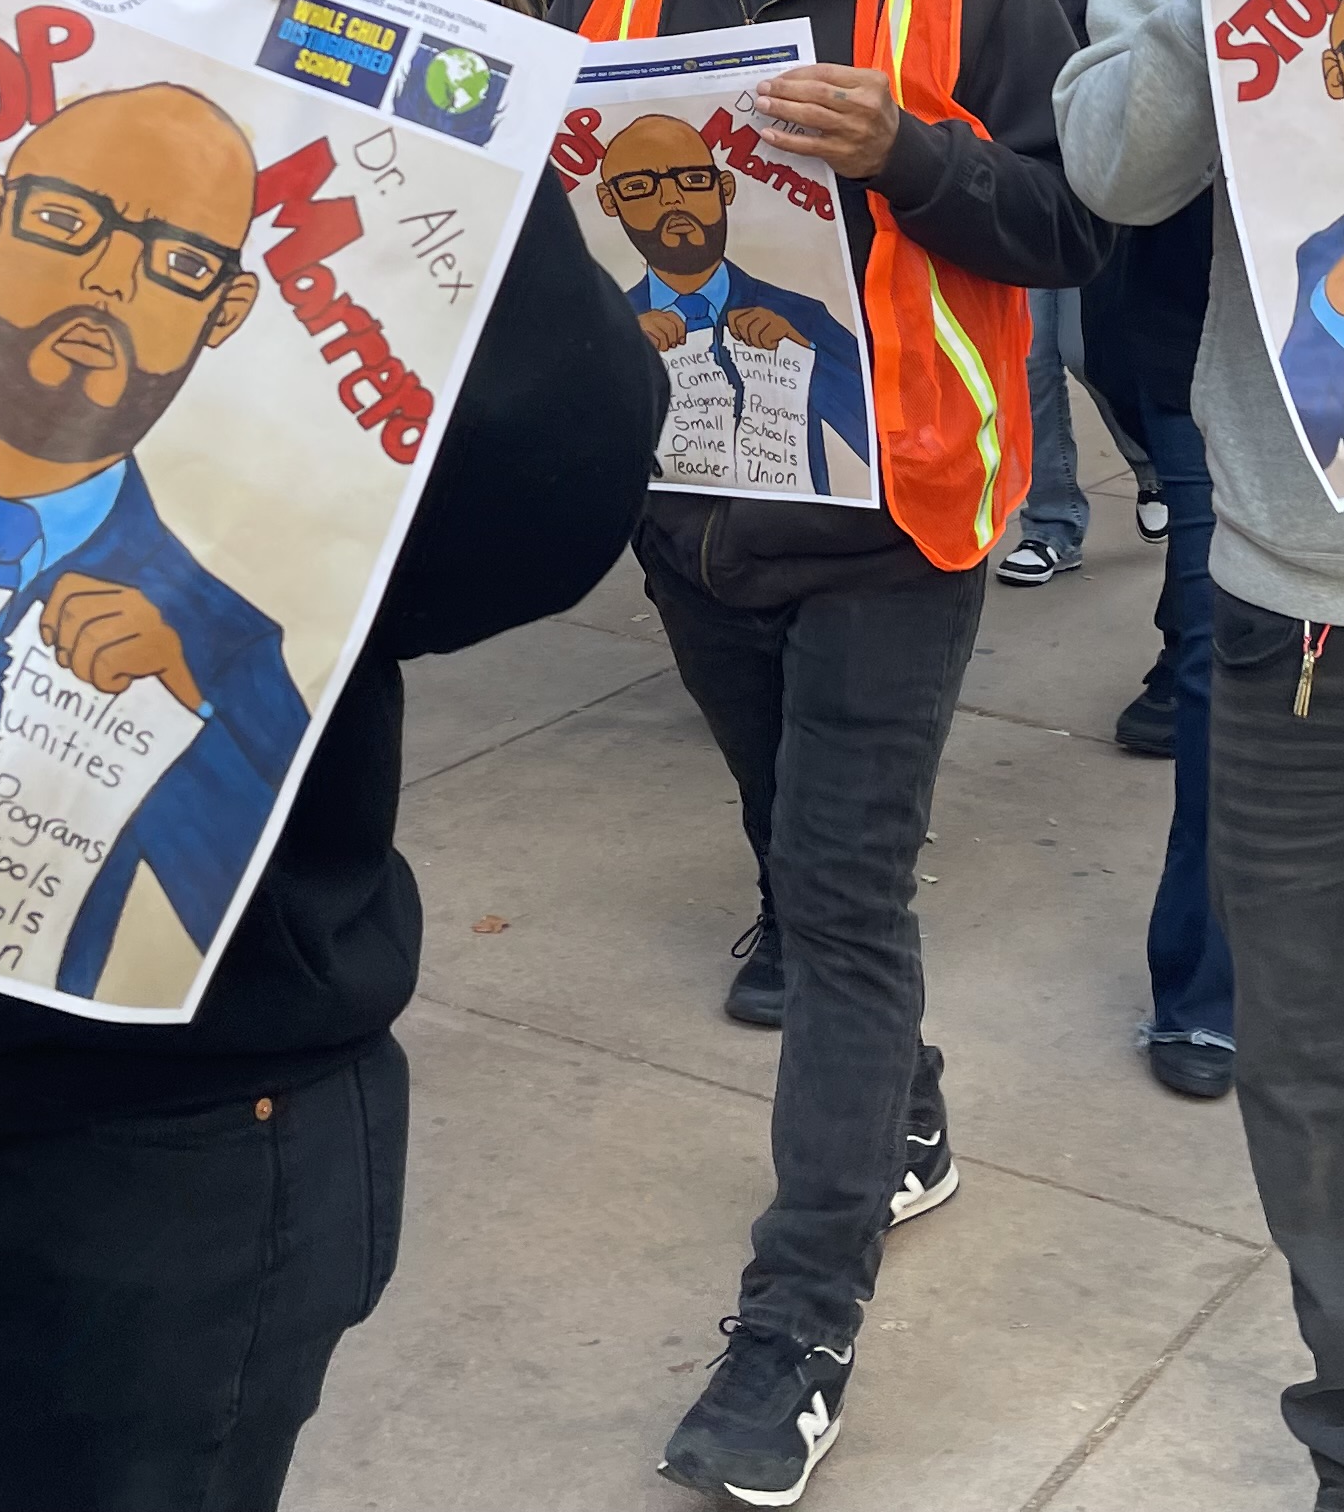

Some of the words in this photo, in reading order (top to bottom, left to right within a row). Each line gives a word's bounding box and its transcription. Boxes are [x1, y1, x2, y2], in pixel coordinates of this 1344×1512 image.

[345, 17, 397, 51] CHILD
[294, 48, 354, 88] SCHOOL
[699, 106, 836, 221] Marrero
[354, 126, 407, 197] Dr.
[398, 209, 474, 305] Alex
[254, 136, 435, 465] Marrero
[733, 342, 801, 373] Families
[677, 370, 726, 390] Comm
[740, 368, 798, 390] unities
[749, 393, 807, 426] Programs
[674, 415, 724, 432] Small
[740, 416, 797, 447] Schools
[672, 434, 727, 454] Online
[740, 437, 798, 467] Schools
[664, 453, 730, 478] Teacher
[747, 459, 797, 486] Union
[10, 645, 155, 757] Families
[4, 708, 126, 789] unities
